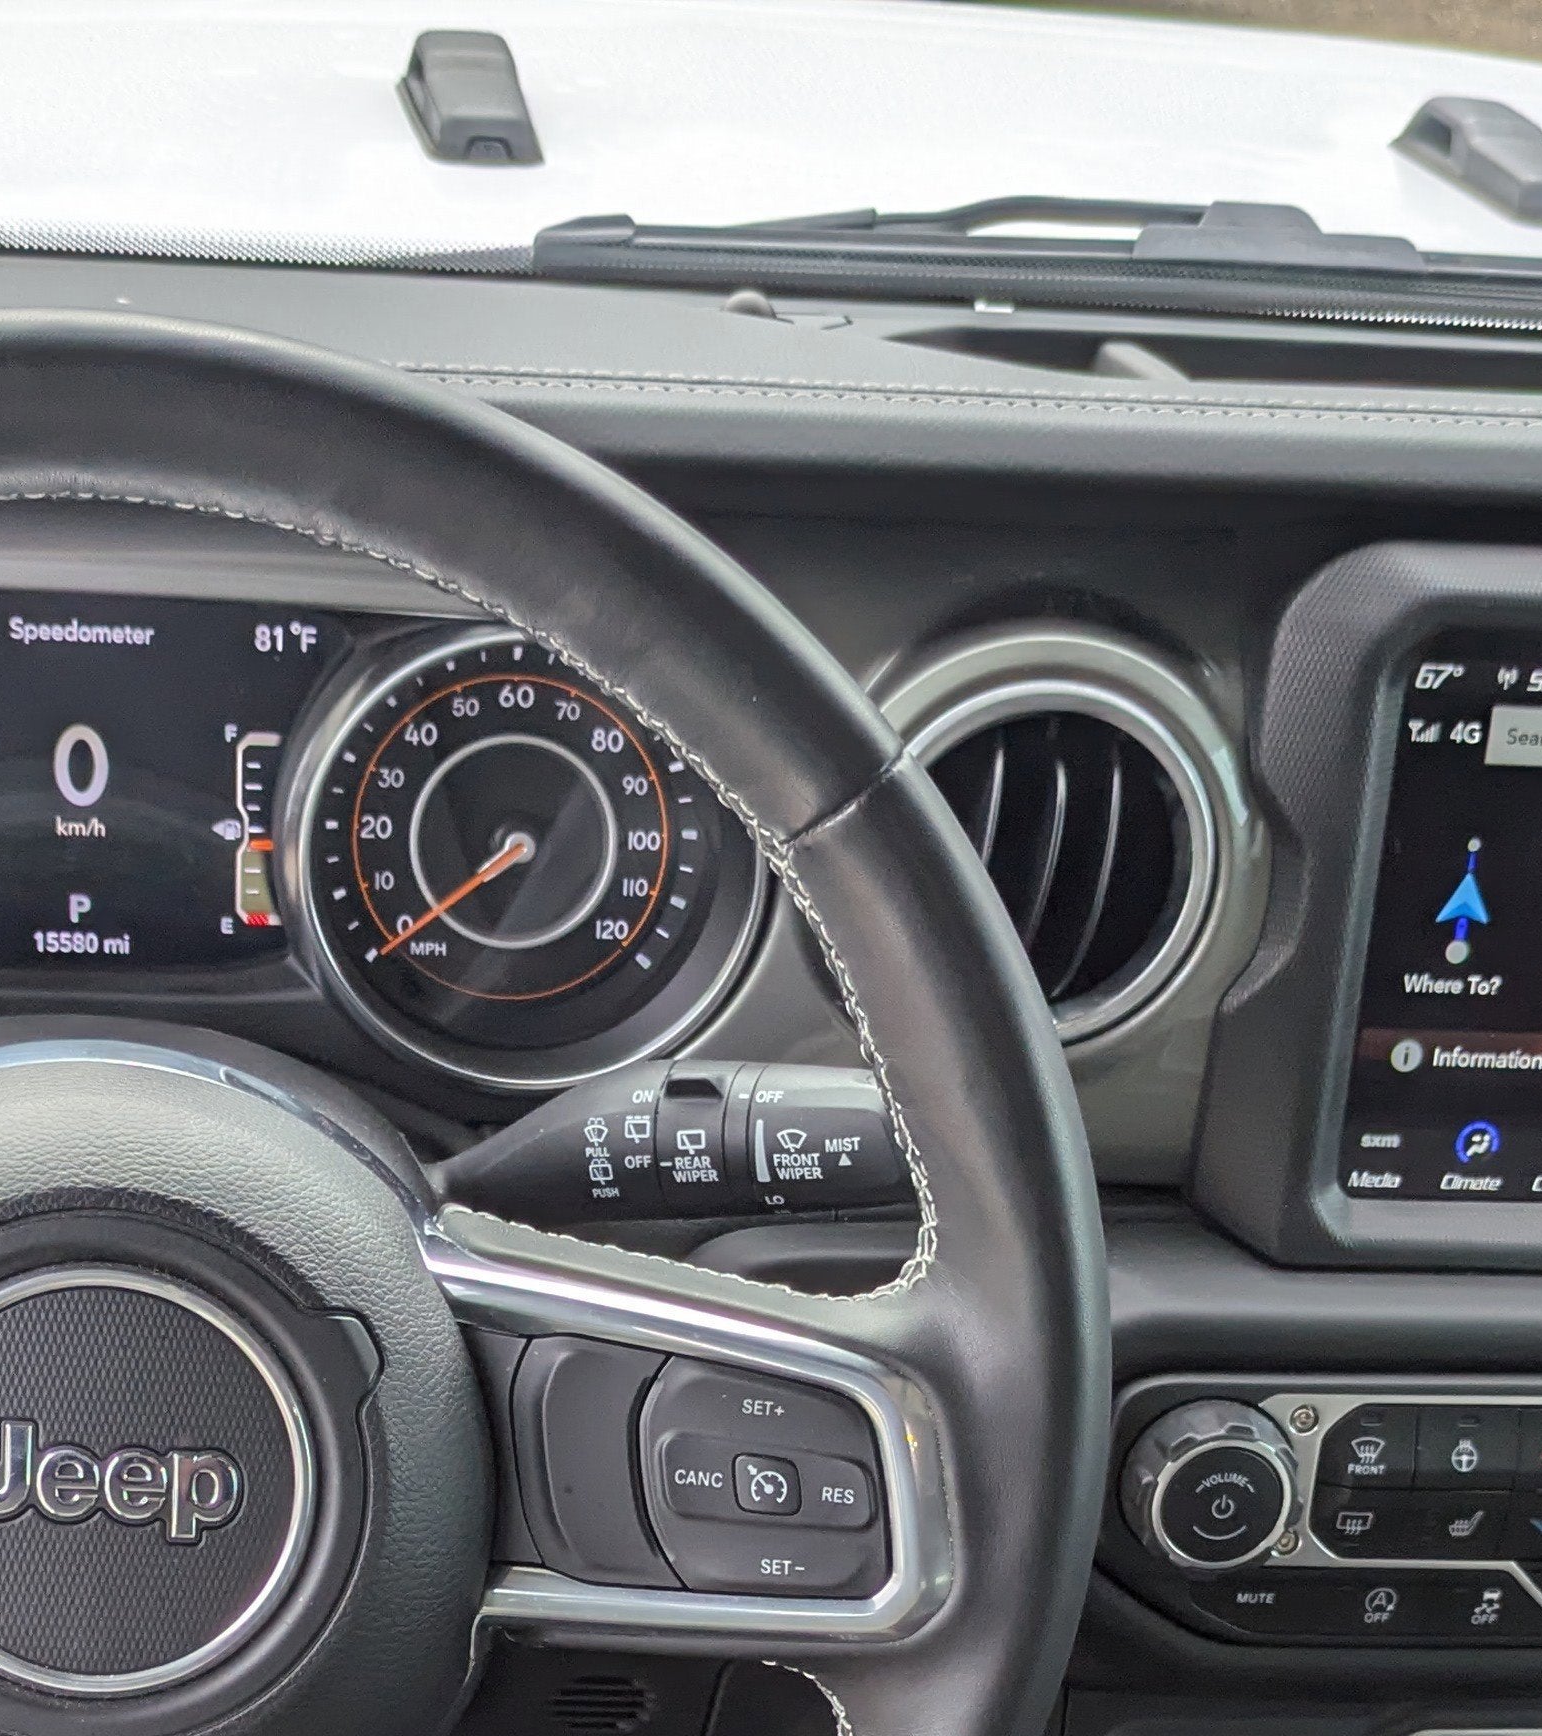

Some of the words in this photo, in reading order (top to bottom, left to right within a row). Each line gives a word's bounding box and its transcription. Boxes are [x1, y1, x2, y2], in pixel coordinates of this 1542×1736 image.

[8, 615, 156, 647] Speedometer
[497, 683, 535, 709] 60
[451, 697, 480, 718] 50
[555, 701, 581, 722] 70
[224, 724, 239, 743] F
[403, 721, 438, 748] 40
[590, 727, 625, 754] 80
[1449, 720, 1483, 745] 4G
[53, 722, 110, 808] 0
[378, 767, 405, 789] 30
[621, 775, 649, 797] 90
[54, 816, 107, 839] km/h
[359, 815, 393, 841] 20
[627, 831, 661, 852] 100
[373, 870, 395, 892] 10
[621, 877, 650, 898] 110
[68, 893, 92, 923] P
[220, 916, 234, 935] E
[396, 914, 415, 936] 0
[594, 918, 630, 941] 120
[33, 931, 99, 955] 15580
[103, 932, 131, 956] mi
[409, 939, 448, 958] MPH
[1403, 972, 1465, 995] Where
[1466, 974, 1504, 997] To?
[631, 1088, 655, 1105] ON
[755, 1089, 784, 1104] OFF
[824, 1137, 861, 1154] MIST
[1359, 1133, 1402, 1149] sxm
[585, 1146, 611, 1159] PULL
[624, 1154, 652, 1170] OFF
[772, 1152, 821, 1168] FRONT
[674, 1155, 712, 1171] REAR
[775, 1165, 824, 1181] WIPER
[672, 1167, 719, 1184] WIPER
[1346, 1170, 1403, 1190] Media
[1439, 1172, 1505, 1192] Climate
[591, 1187, 621, 1200] PUSH
[763, 1194, 786, 1206] LO
[673, 1468, 724, 1490] CANC
[1346, 1463, 1387, 1476] FRONT
[1200, 1471, 1250, 1489] VOLUME
[821, 1485, 856, 1507] RES
[1235, 1592, 1277, 1605] MUTE
[1363, 1611, 1391, 1624] OFF
[1470, 1609, 1500, 1626] OFF
